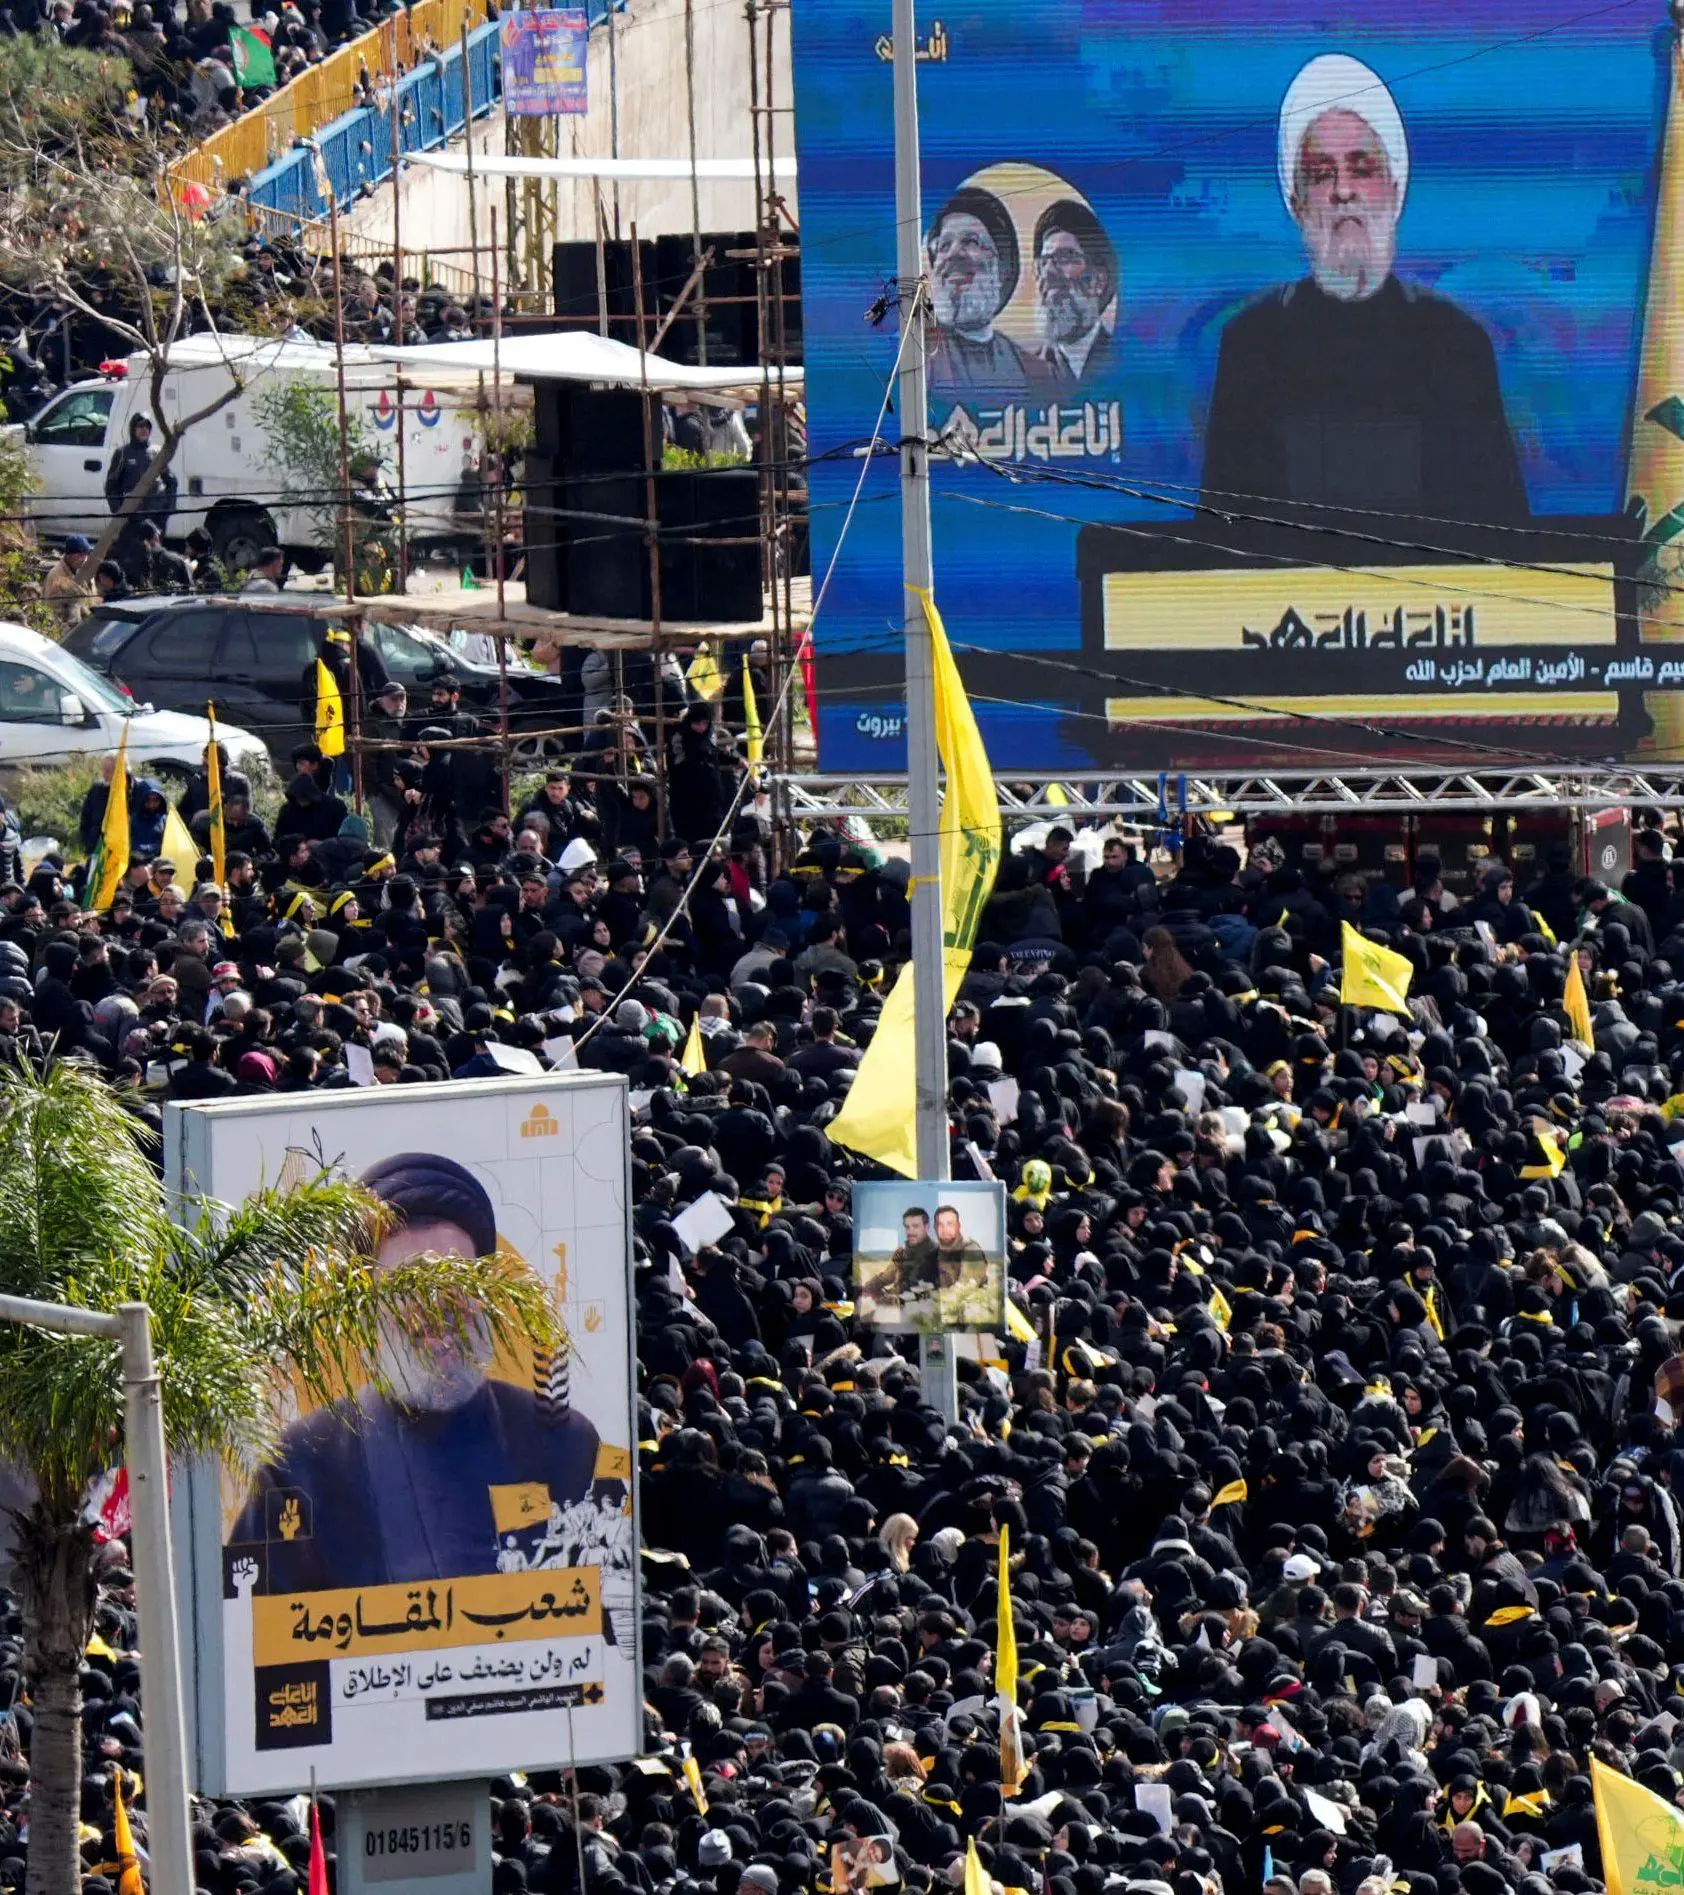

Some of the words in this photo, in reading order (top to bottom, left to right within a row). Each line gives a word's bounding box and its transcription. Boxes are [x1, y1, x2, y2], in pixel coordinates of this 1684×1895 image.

[1405, 658, 1436, 682] الله
[1439, 657, 1484, 687] لحزب
[1486, 657, 1532, 687] العام
[1535, 650, 1586, 685] الأمين
[1604, 656, 1654, 686] قاسم
[856, 712, 901, 738] بيروت
[291, 1583, 454, 1651] المقاومة
[460, 1577, 593, 1642] شعب
[416, 1659, 453, 1691] على
[459, 1655, 525, 1684] يضعف
[529, 1648, 563, 1682] ولن
[569, 1647, 591, 1679] لم
[343, 1661, 411, 1700] الإطلاق
[365, 1819, 471, 1857] 01845115/6
